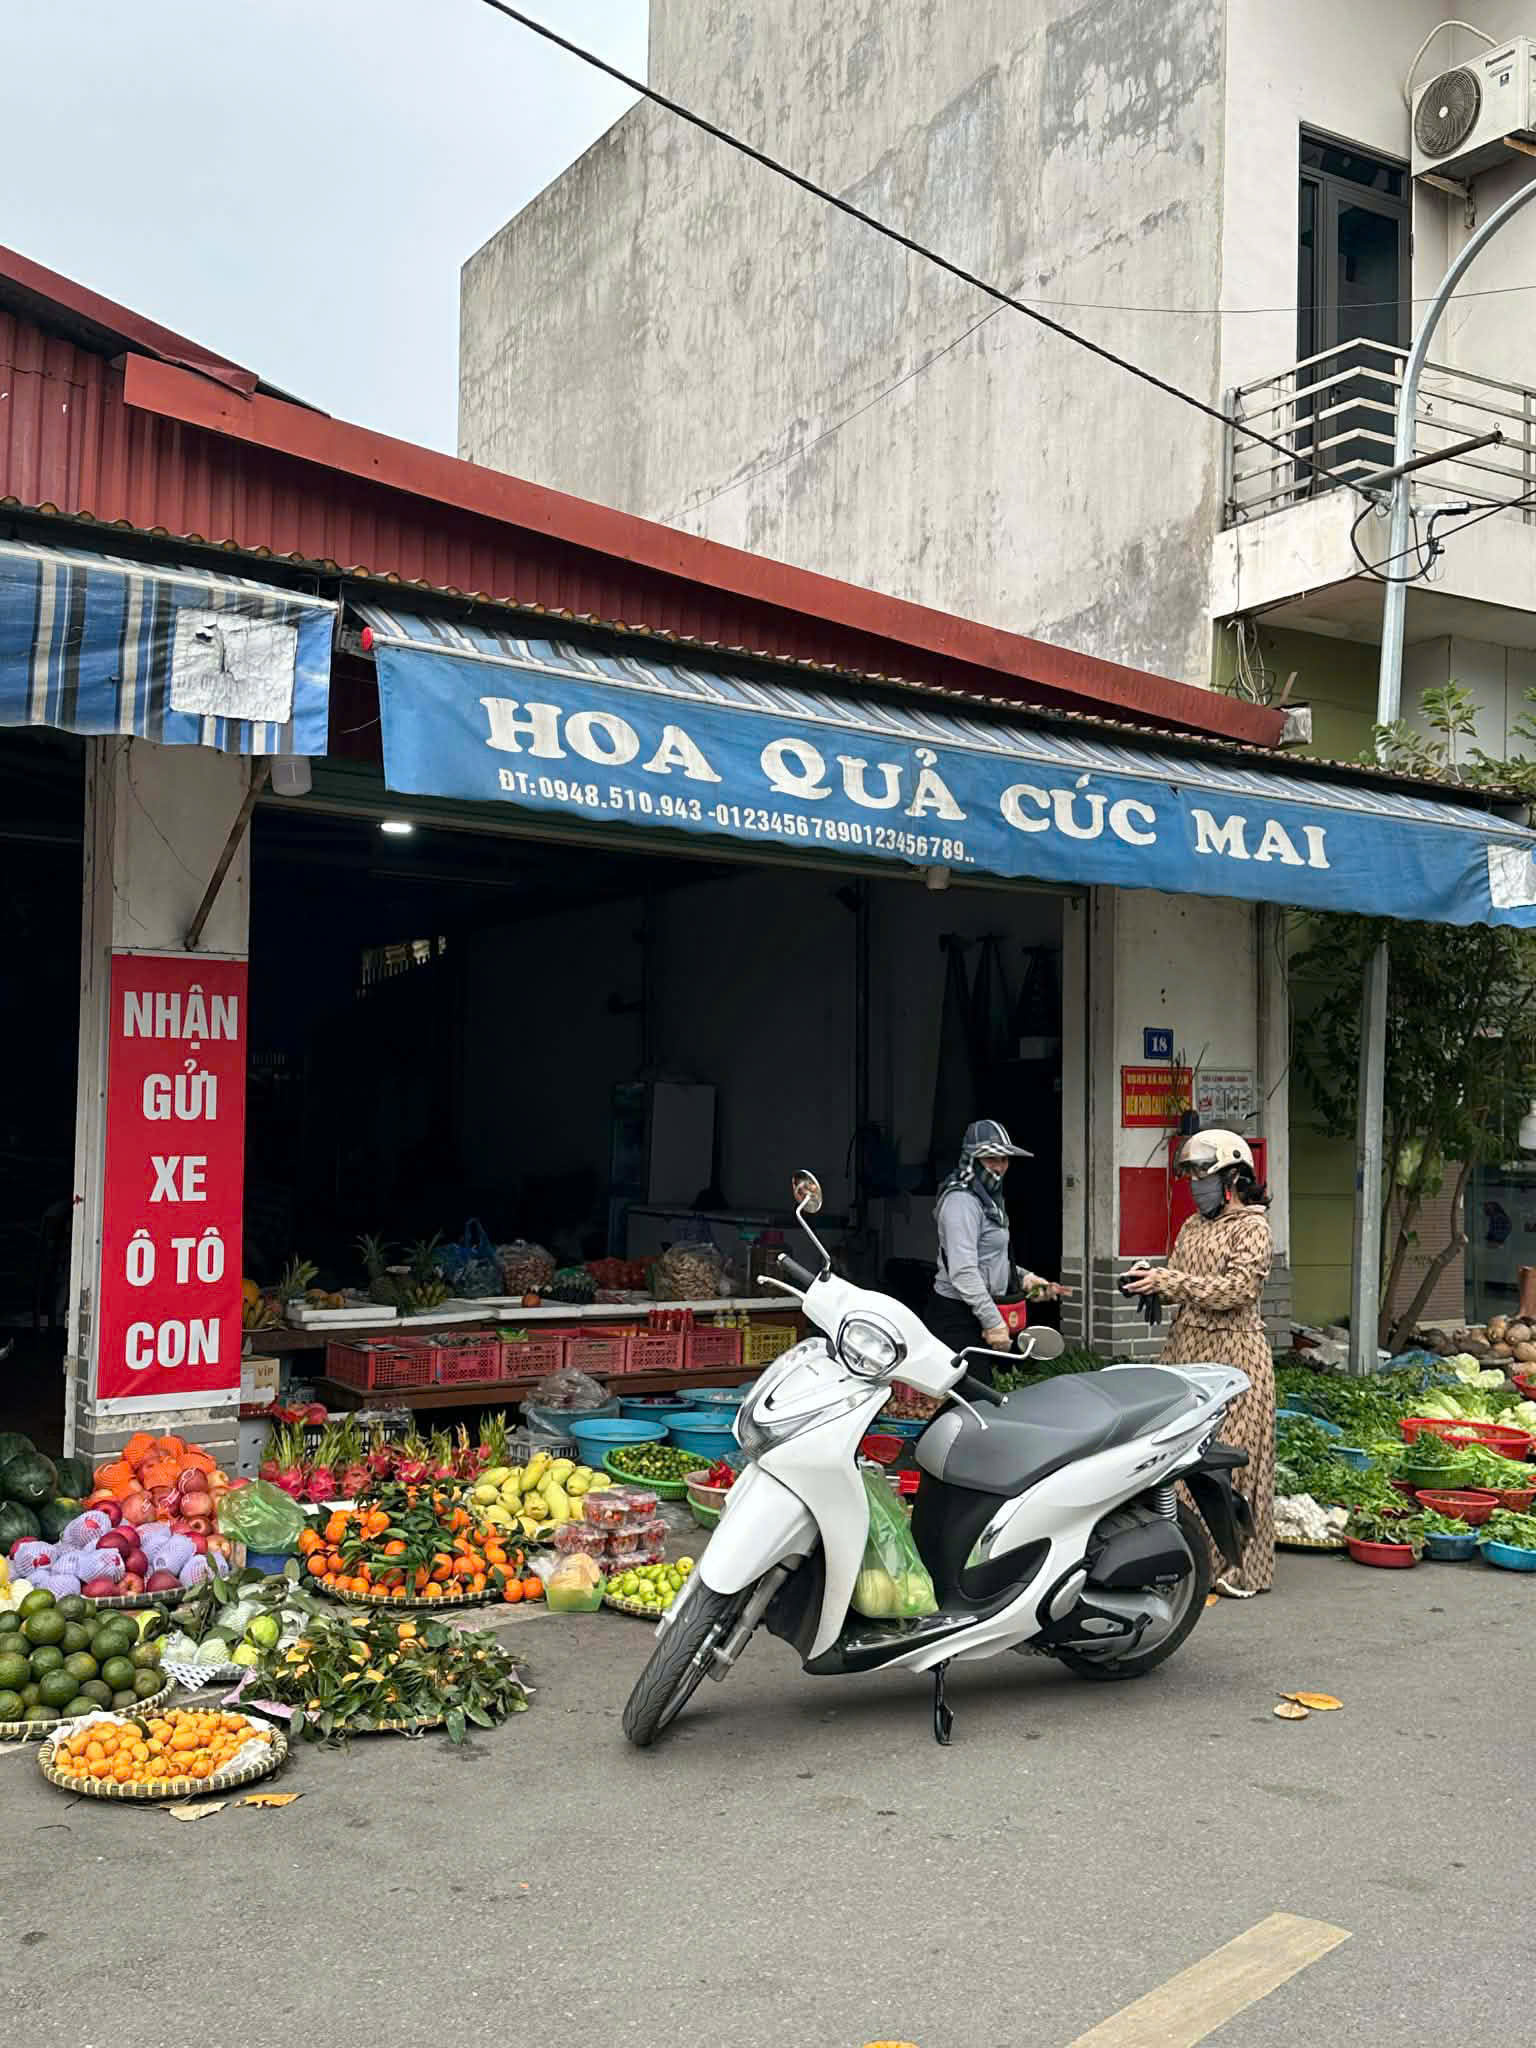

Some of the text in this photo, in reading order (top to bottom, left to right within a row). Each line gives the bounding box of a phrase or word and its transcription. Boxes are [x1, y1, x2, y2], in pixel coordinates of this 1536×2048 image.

[479, 696, 1331, 870] HOA QUẢ CÚC MAI
[123, 984, 239, 1050] NHẬN
[1152, 1036, 1168, 1052] 18
[142, 1058, 217, 1121] GỬI
[148, 1155, 207, 1202] XE
[126, 1226, 225, 1287] Ô TÔ
[125, 1317, 221, 1370] CON
